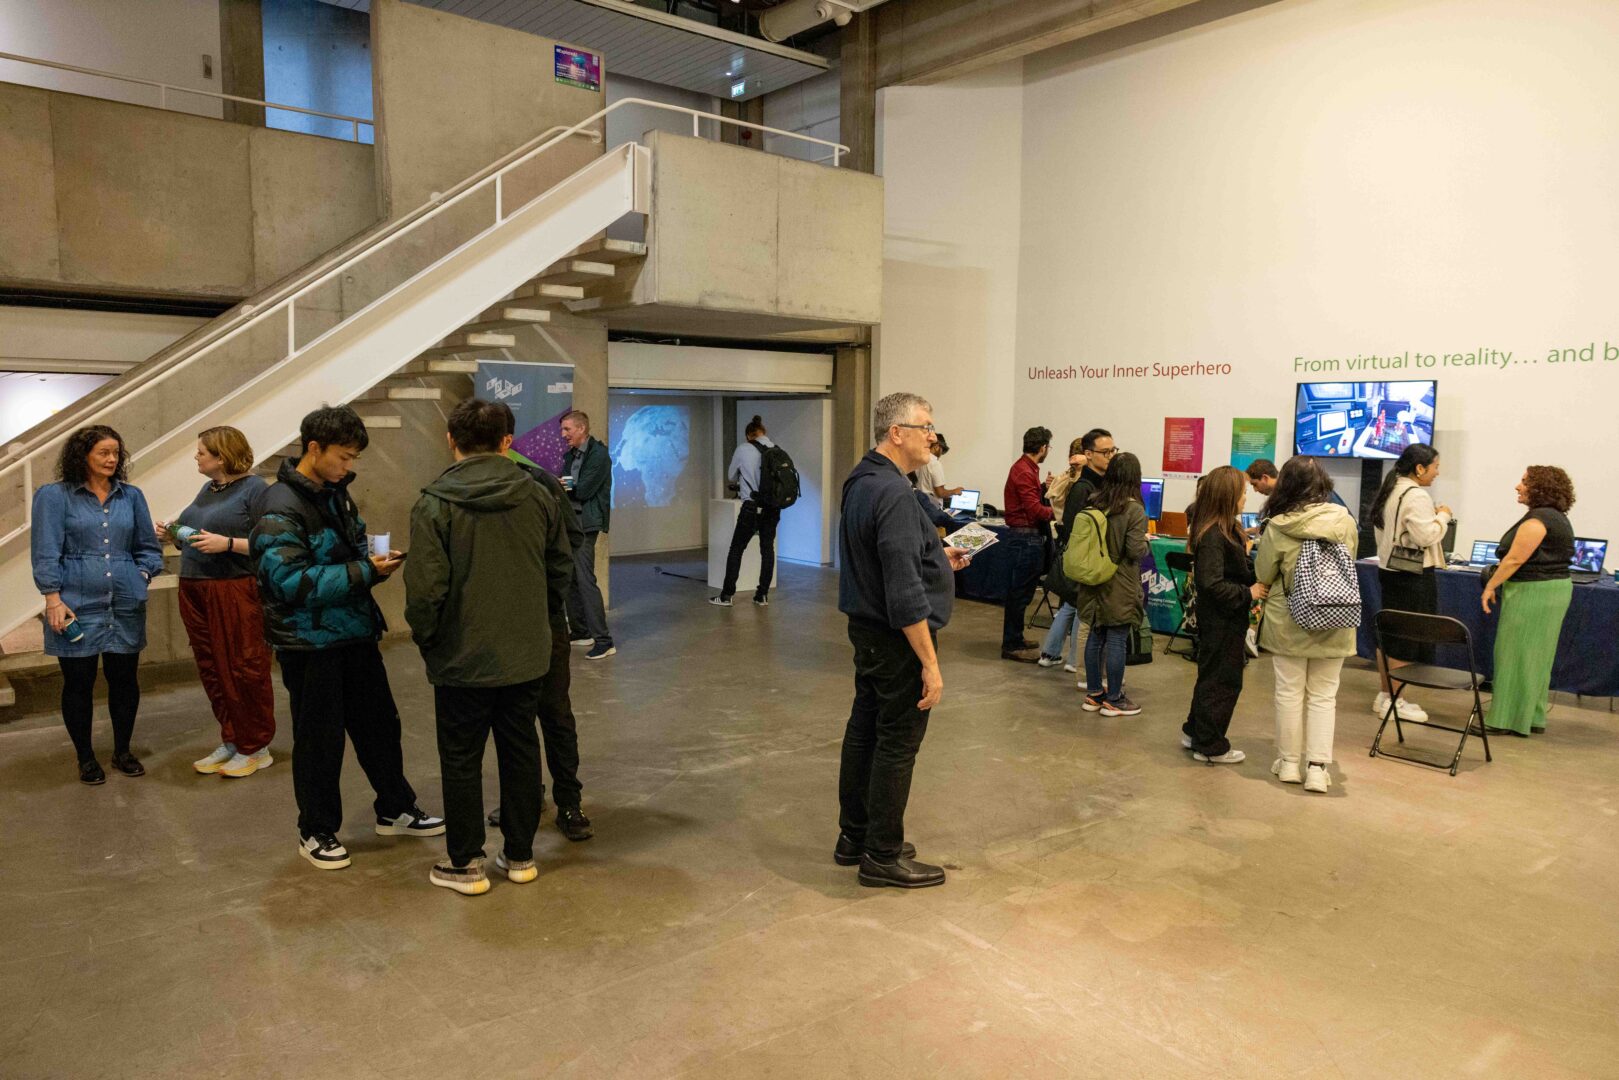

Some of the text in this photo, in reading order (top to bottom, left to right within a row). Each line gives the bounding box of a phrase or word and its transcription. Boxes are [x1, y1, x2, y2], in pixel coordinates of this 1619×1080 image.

[1293, 356, 1340, 373] From
[1345, 352, 1408, 371] virtual
[1414, 352, 1437, 368] to
[1546, 341, 1595, 364] and
[1028, 360, 1232, 381] Unleash Your Inner Superhero
